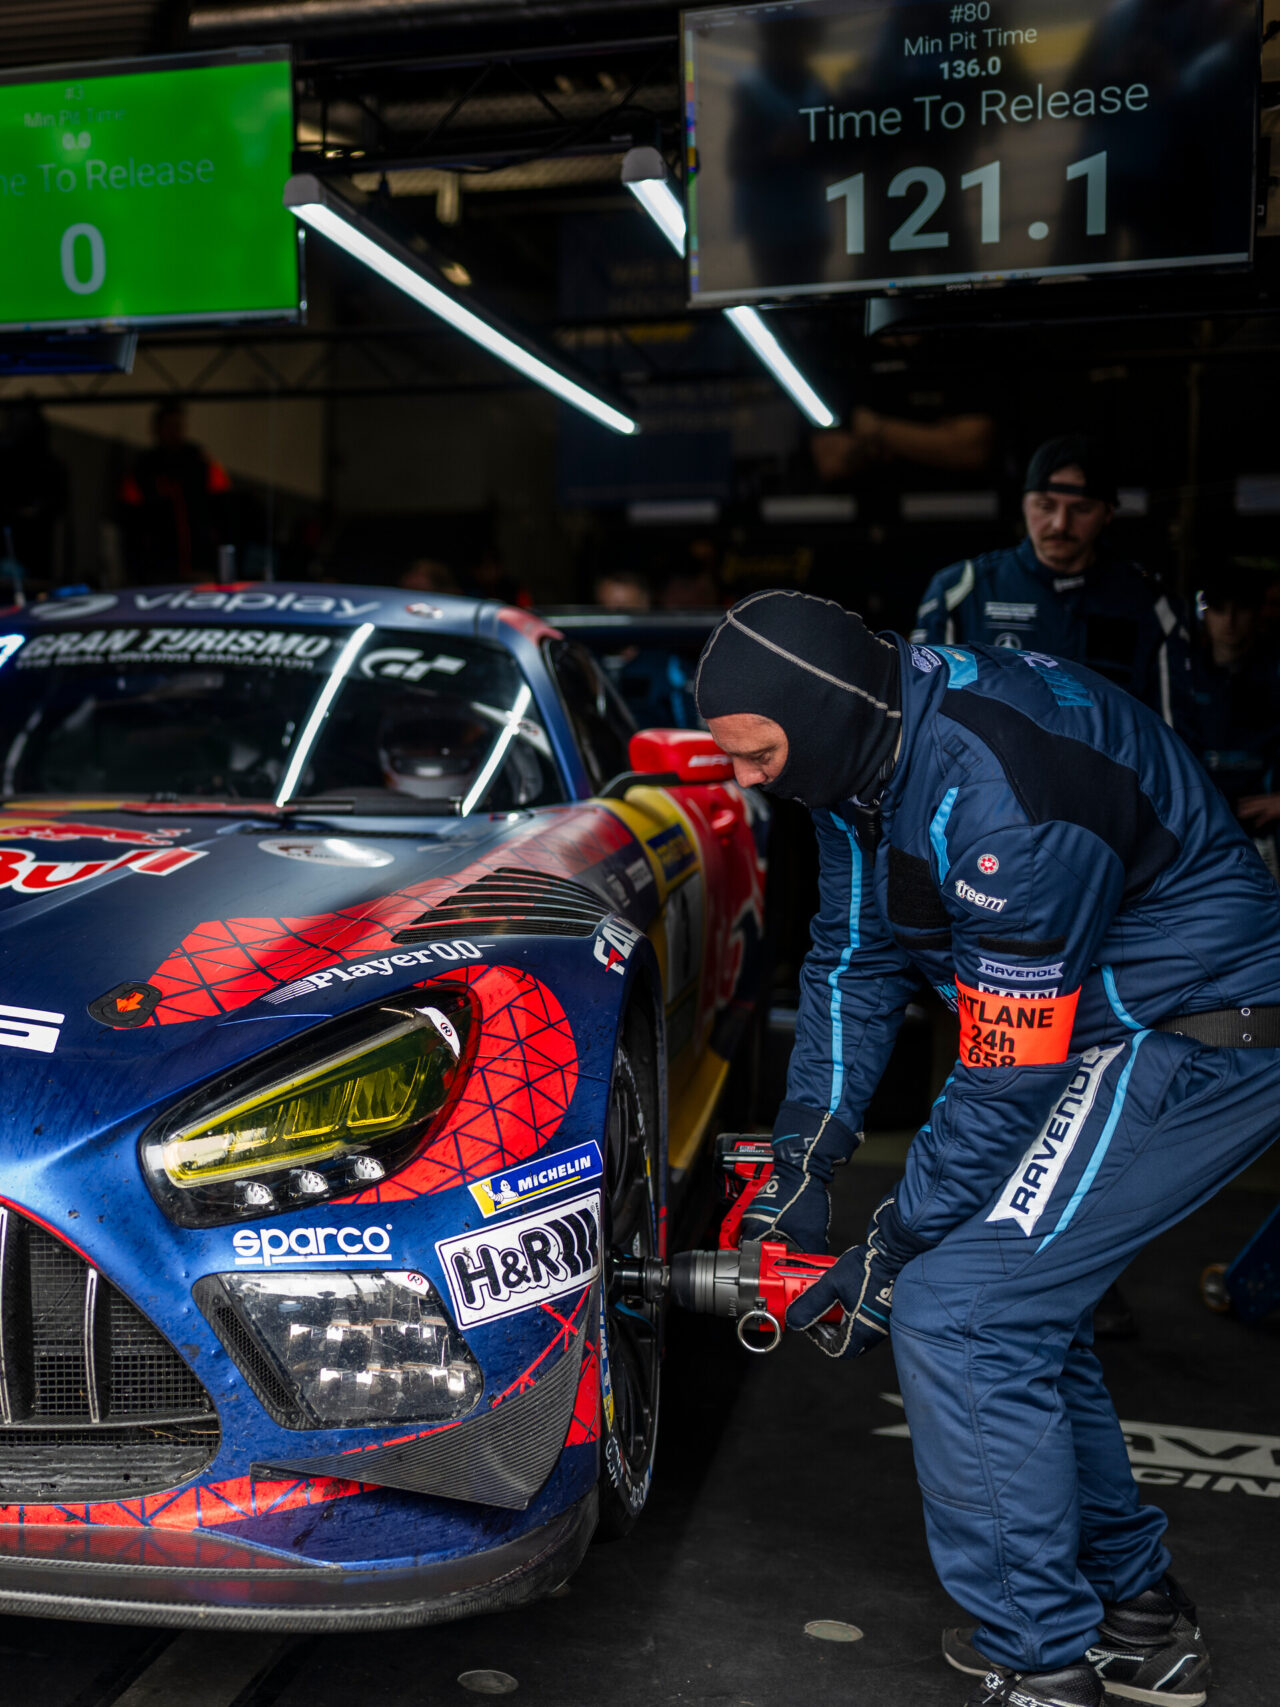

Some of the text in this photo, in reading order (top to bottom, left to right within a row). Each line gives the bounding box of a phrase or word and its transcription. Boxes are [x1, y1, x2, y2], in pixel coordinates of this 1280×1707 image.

[949, 1, 991, 24] #80
[903, 28, 1038, 57] Min Pit Time
[939, 57, 1002, 80] 136.0
[798, 82, 1150, 143] Time To Release
[36, 163, 76, 192] To
[85, 157, 215, 190] Release
[825, 150, 1108, 256] 121.1
[60, 222, 107, 295] 0
[135, 591, 381, 618] viaplay
[21, 630, 140, 660] GRAN
[955, 879, 1007, 913] freem
[984, 963, 1057, 979] RAVENOL
[971, 1024, 1015, 1053] 24h
[1009, 1054, 1104, 1215] RAVENOL
[518, 1155, 592, 1191] MICHELIN
[233, 1226, 389, 1266] sparco
[454, 1230, 561, 1305] H&R
